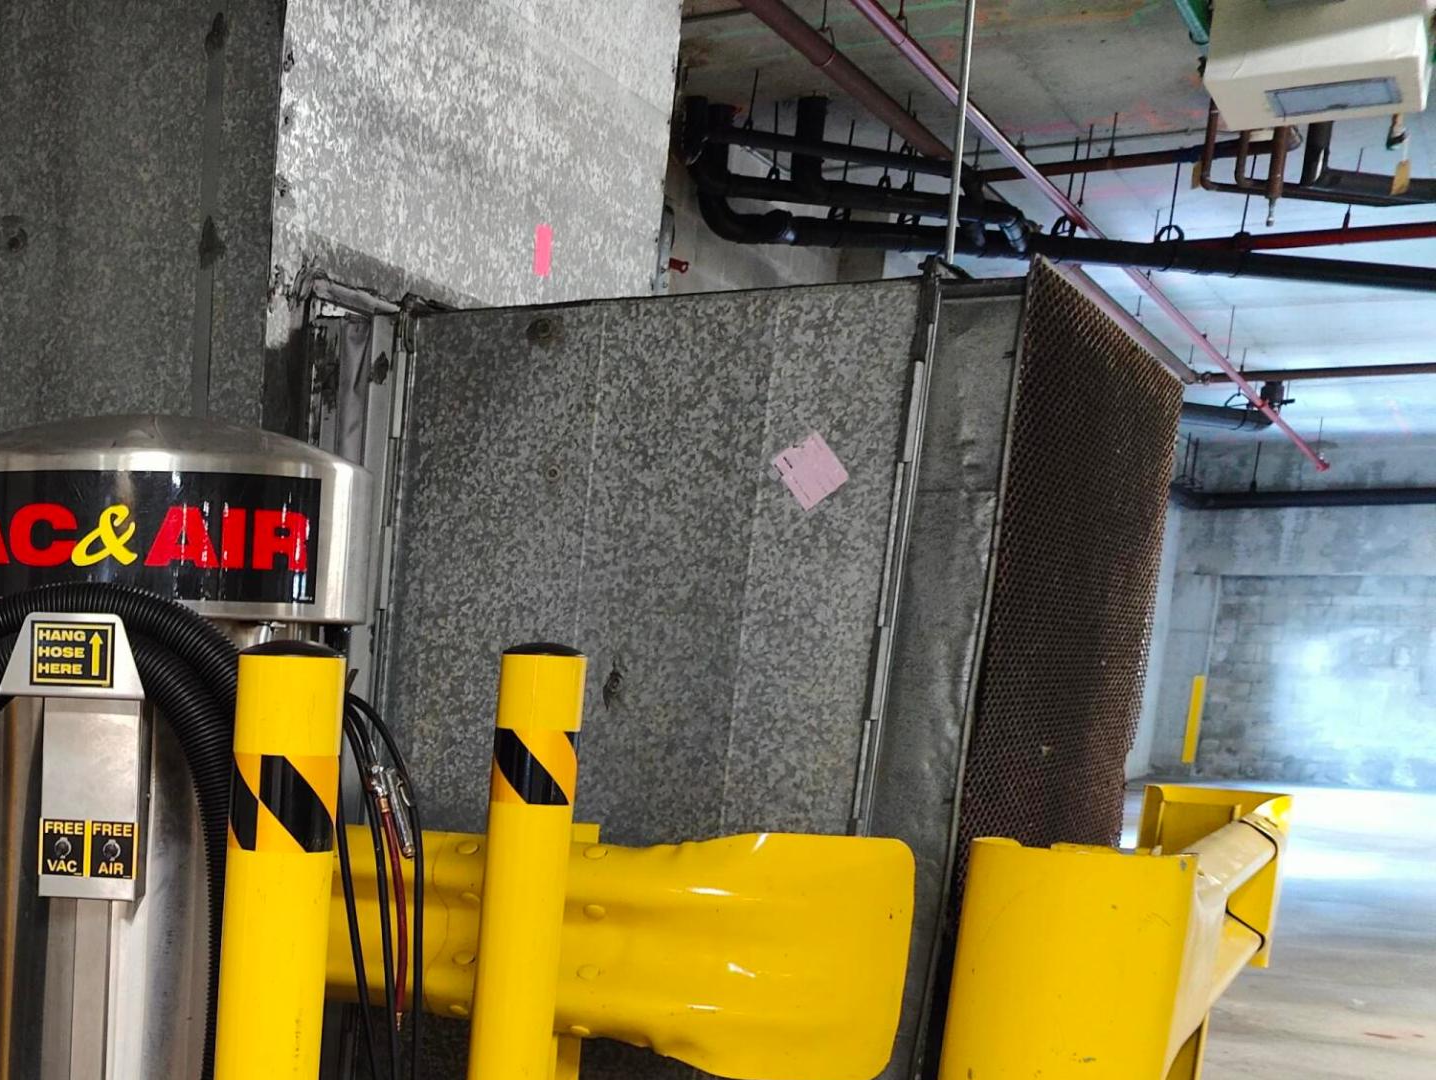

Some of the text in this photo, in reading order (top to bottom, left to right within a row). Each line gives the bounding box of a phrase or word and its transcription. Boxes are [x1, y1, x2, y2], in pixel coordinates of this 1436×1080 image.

[71, 505, 138, 567] &
[144, 505, 310, 571] AIR
[38, 630, 86, 642] HANG
[38, 646, 85, 658] HOSE
[38, 662, 83, 675] HERE
[44, 821, 84, 835] FREE
[92, 823, 132, 837] FREE
[47, 859, 77, 873] VAC
[98, 862, 124, 875] AIR
